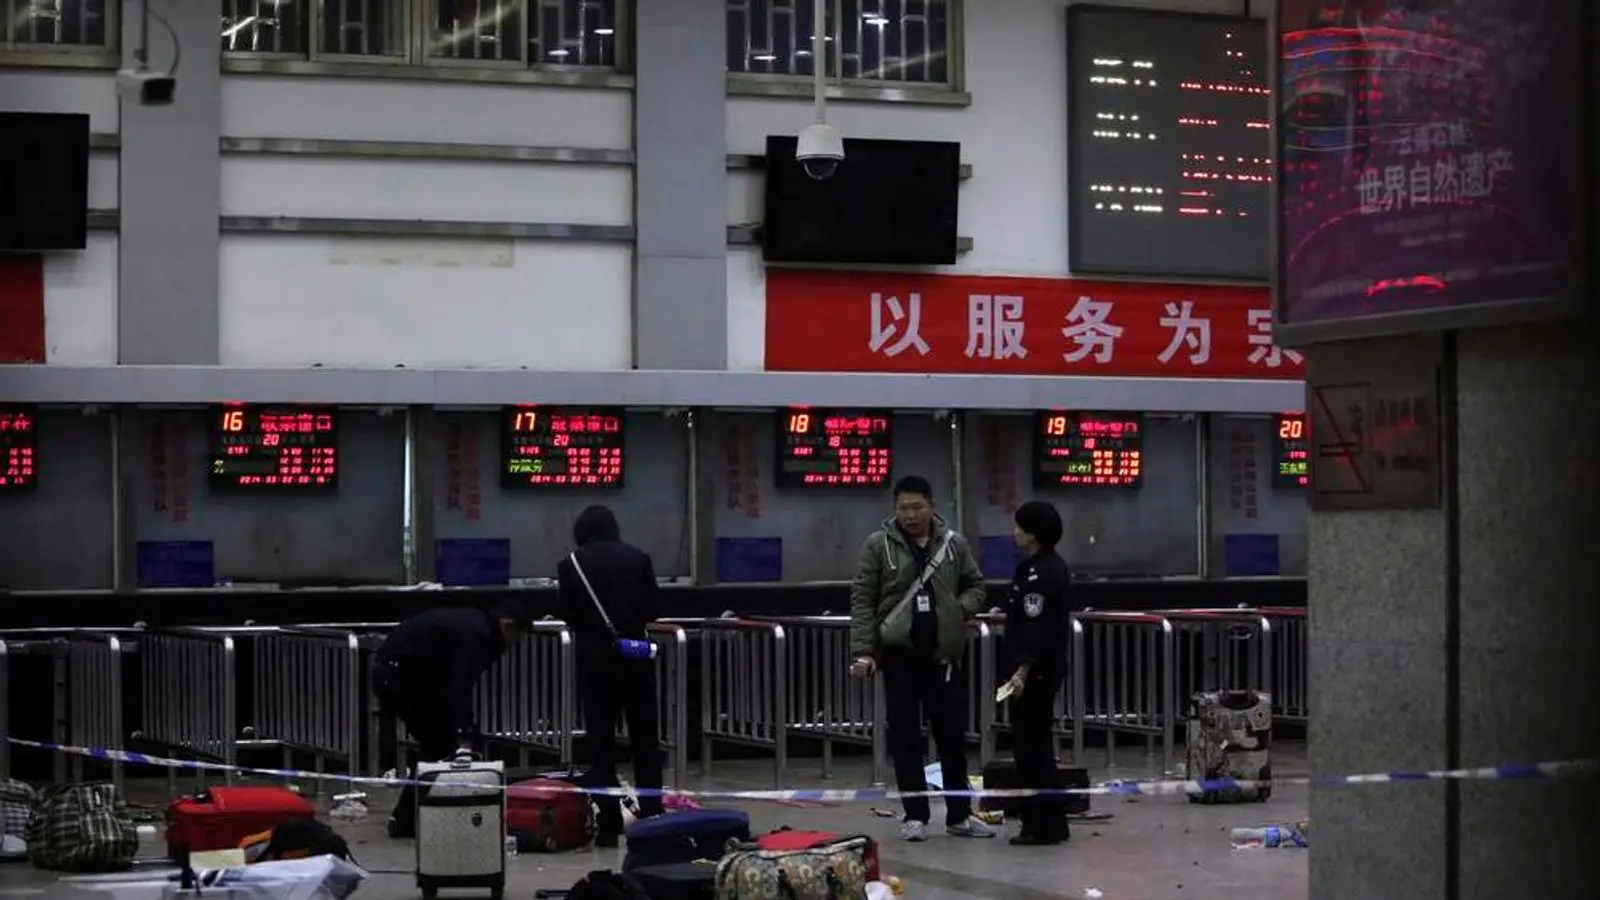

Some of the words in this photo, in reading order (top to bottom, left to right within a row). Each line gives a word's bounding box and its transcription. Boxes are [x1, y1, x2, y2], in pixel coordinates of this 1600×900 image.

[1356, 147, 1515, 215] 世界自然遗产
[223, 411, 243, 431] 16
[515, 412, 536, 431] 17
[790, 414, 810, 433] 18
[1047, 416, 1067, 435] 19
[1279, 420, 1303, 439] 20
[262, 433, 280, 446] 20
[553, 434, 570, 446] 20
